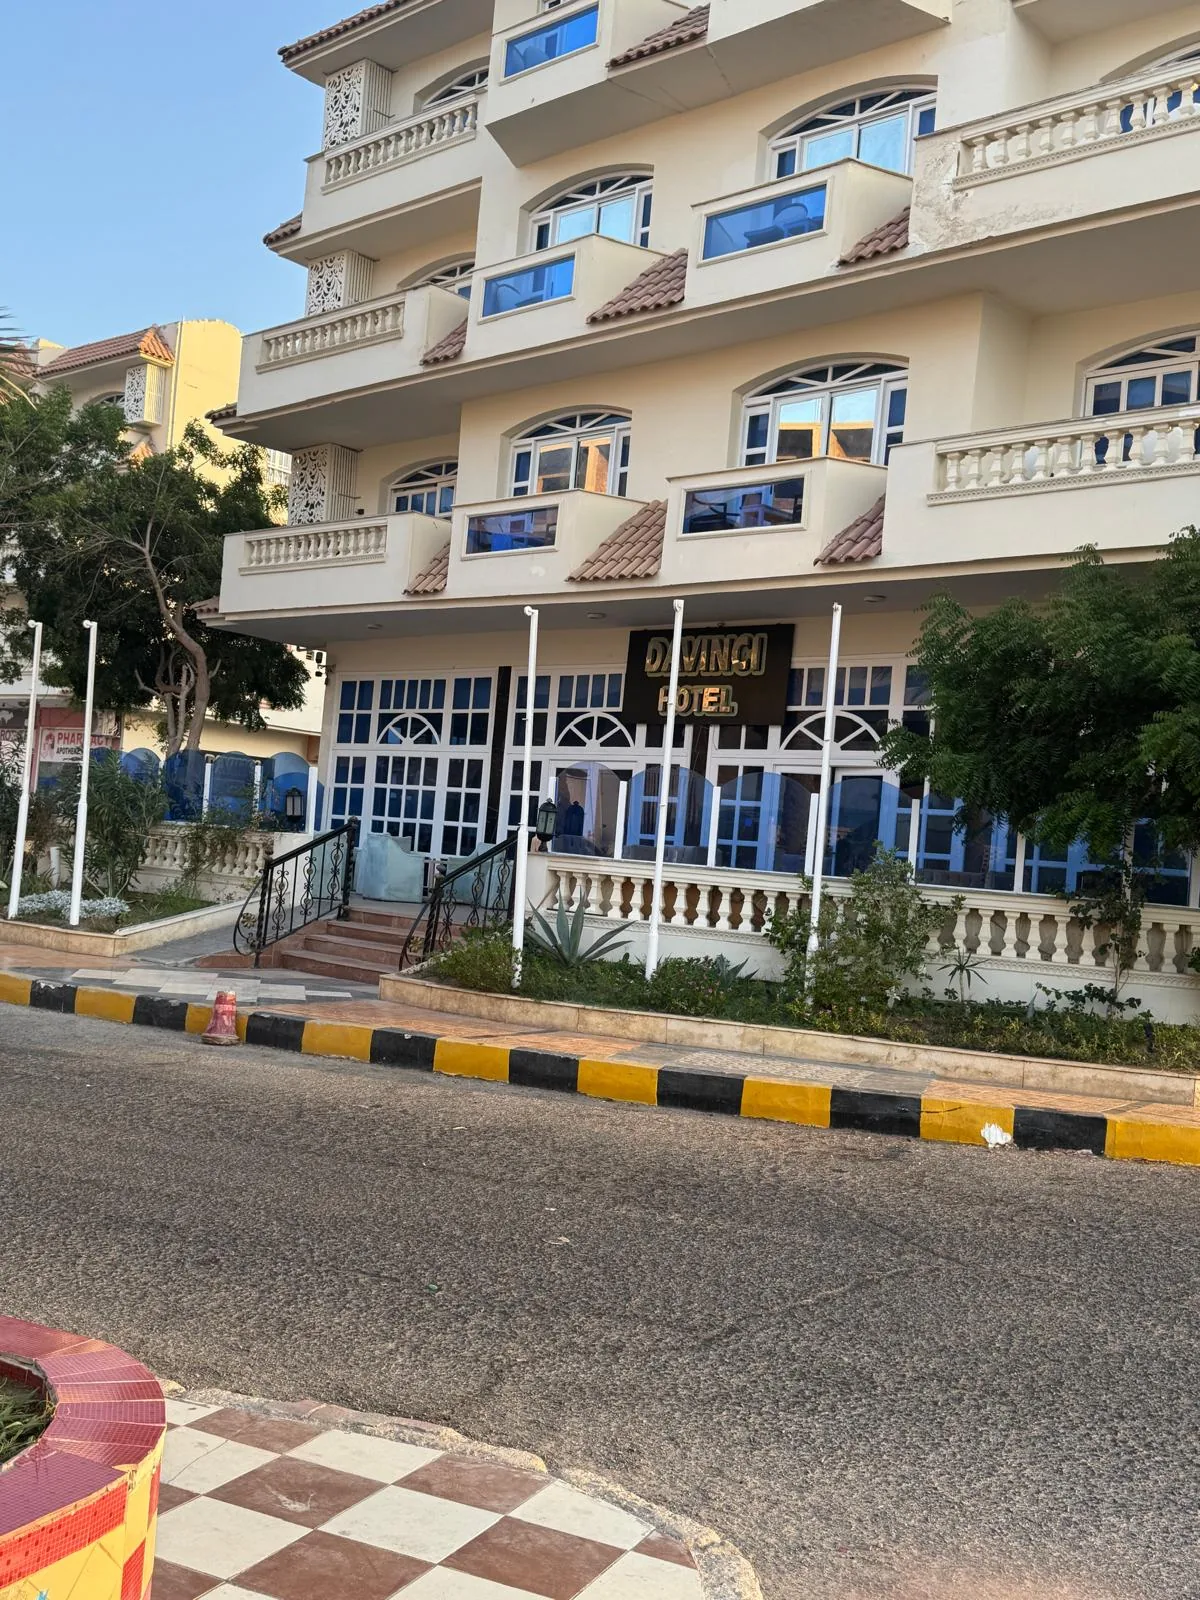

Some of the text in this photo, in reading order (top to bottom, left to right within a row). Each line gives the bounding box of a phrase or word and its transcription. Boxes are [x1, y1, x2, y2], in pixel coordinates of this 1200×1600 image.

[645, 634, 764, 673] DAVINCI
[658, 686, 735, 714] HOTEL
[57, 732, 110, 746] PHARACY
